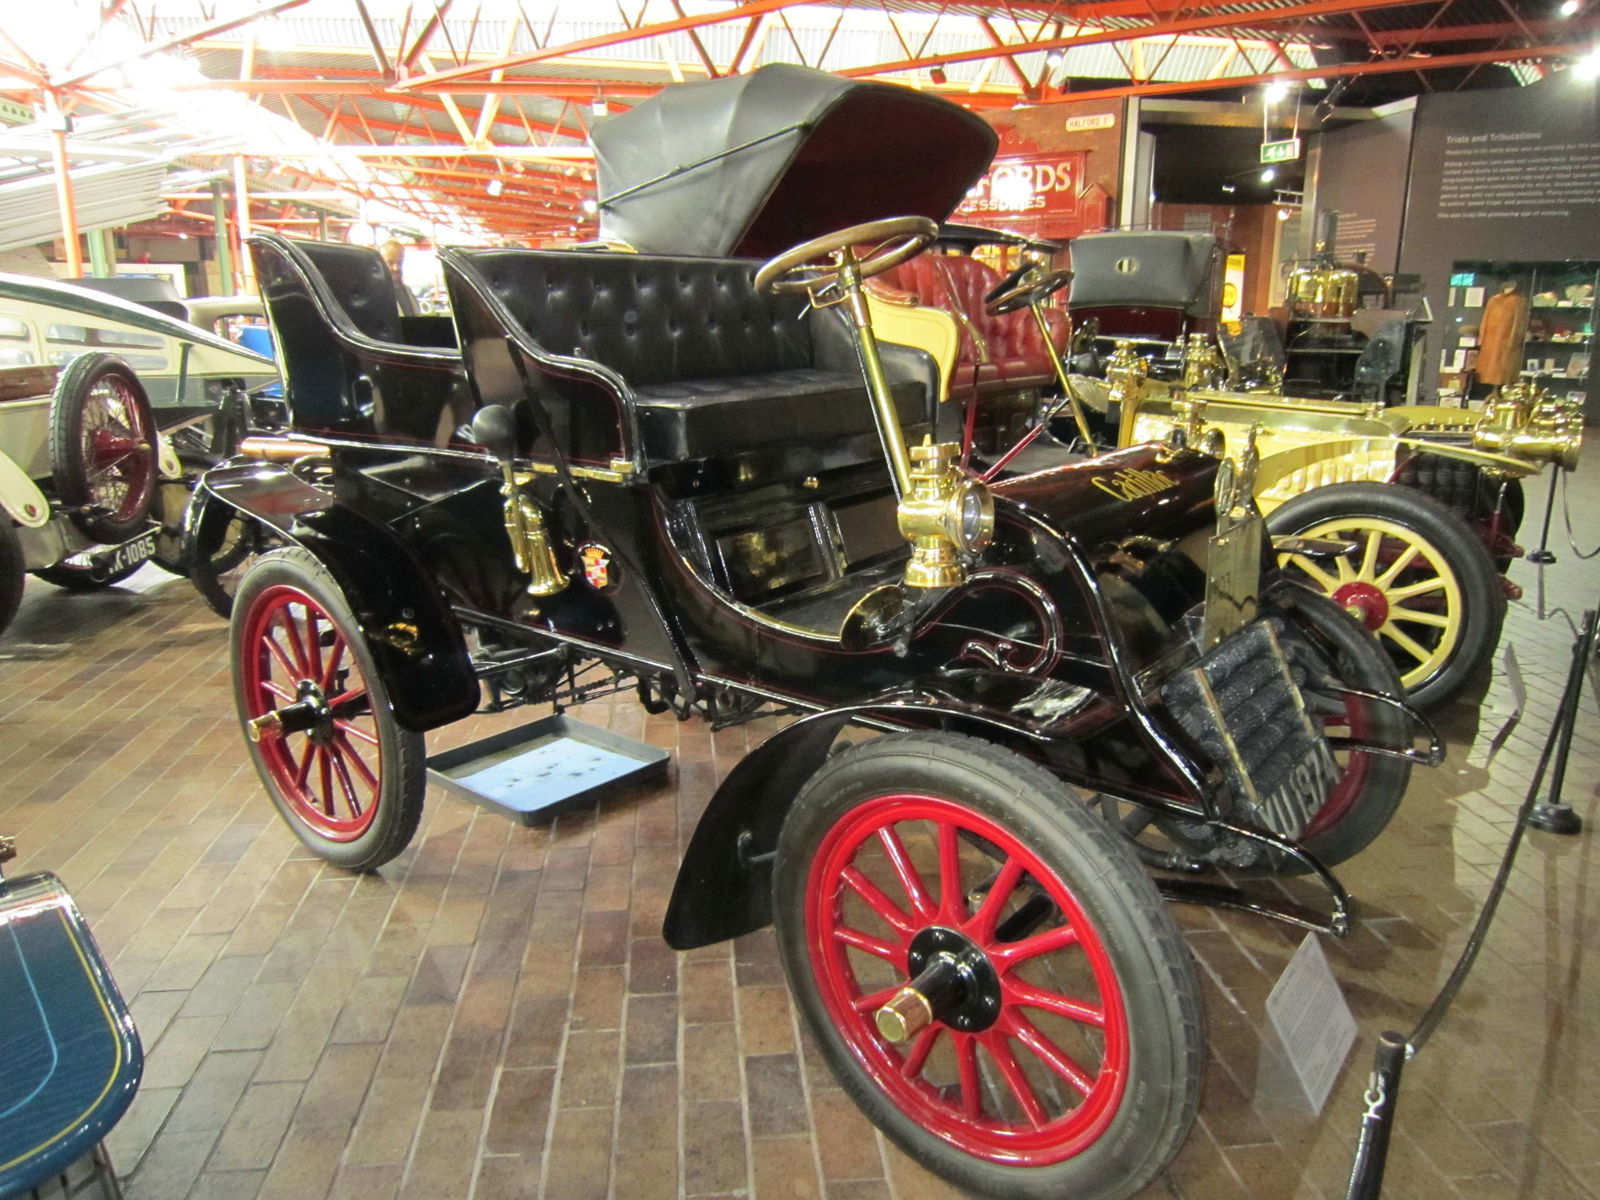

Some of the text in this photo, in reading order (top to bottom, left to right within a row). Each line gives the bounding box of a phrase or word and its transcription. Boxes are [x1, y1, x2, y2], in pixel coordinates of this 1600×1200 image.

[1070, 117, 1100, 129] HALFORD
[1447, 132, 1542, 144] Trials and Tribulations
[1092, 468, 1179, 502] Cadillac
